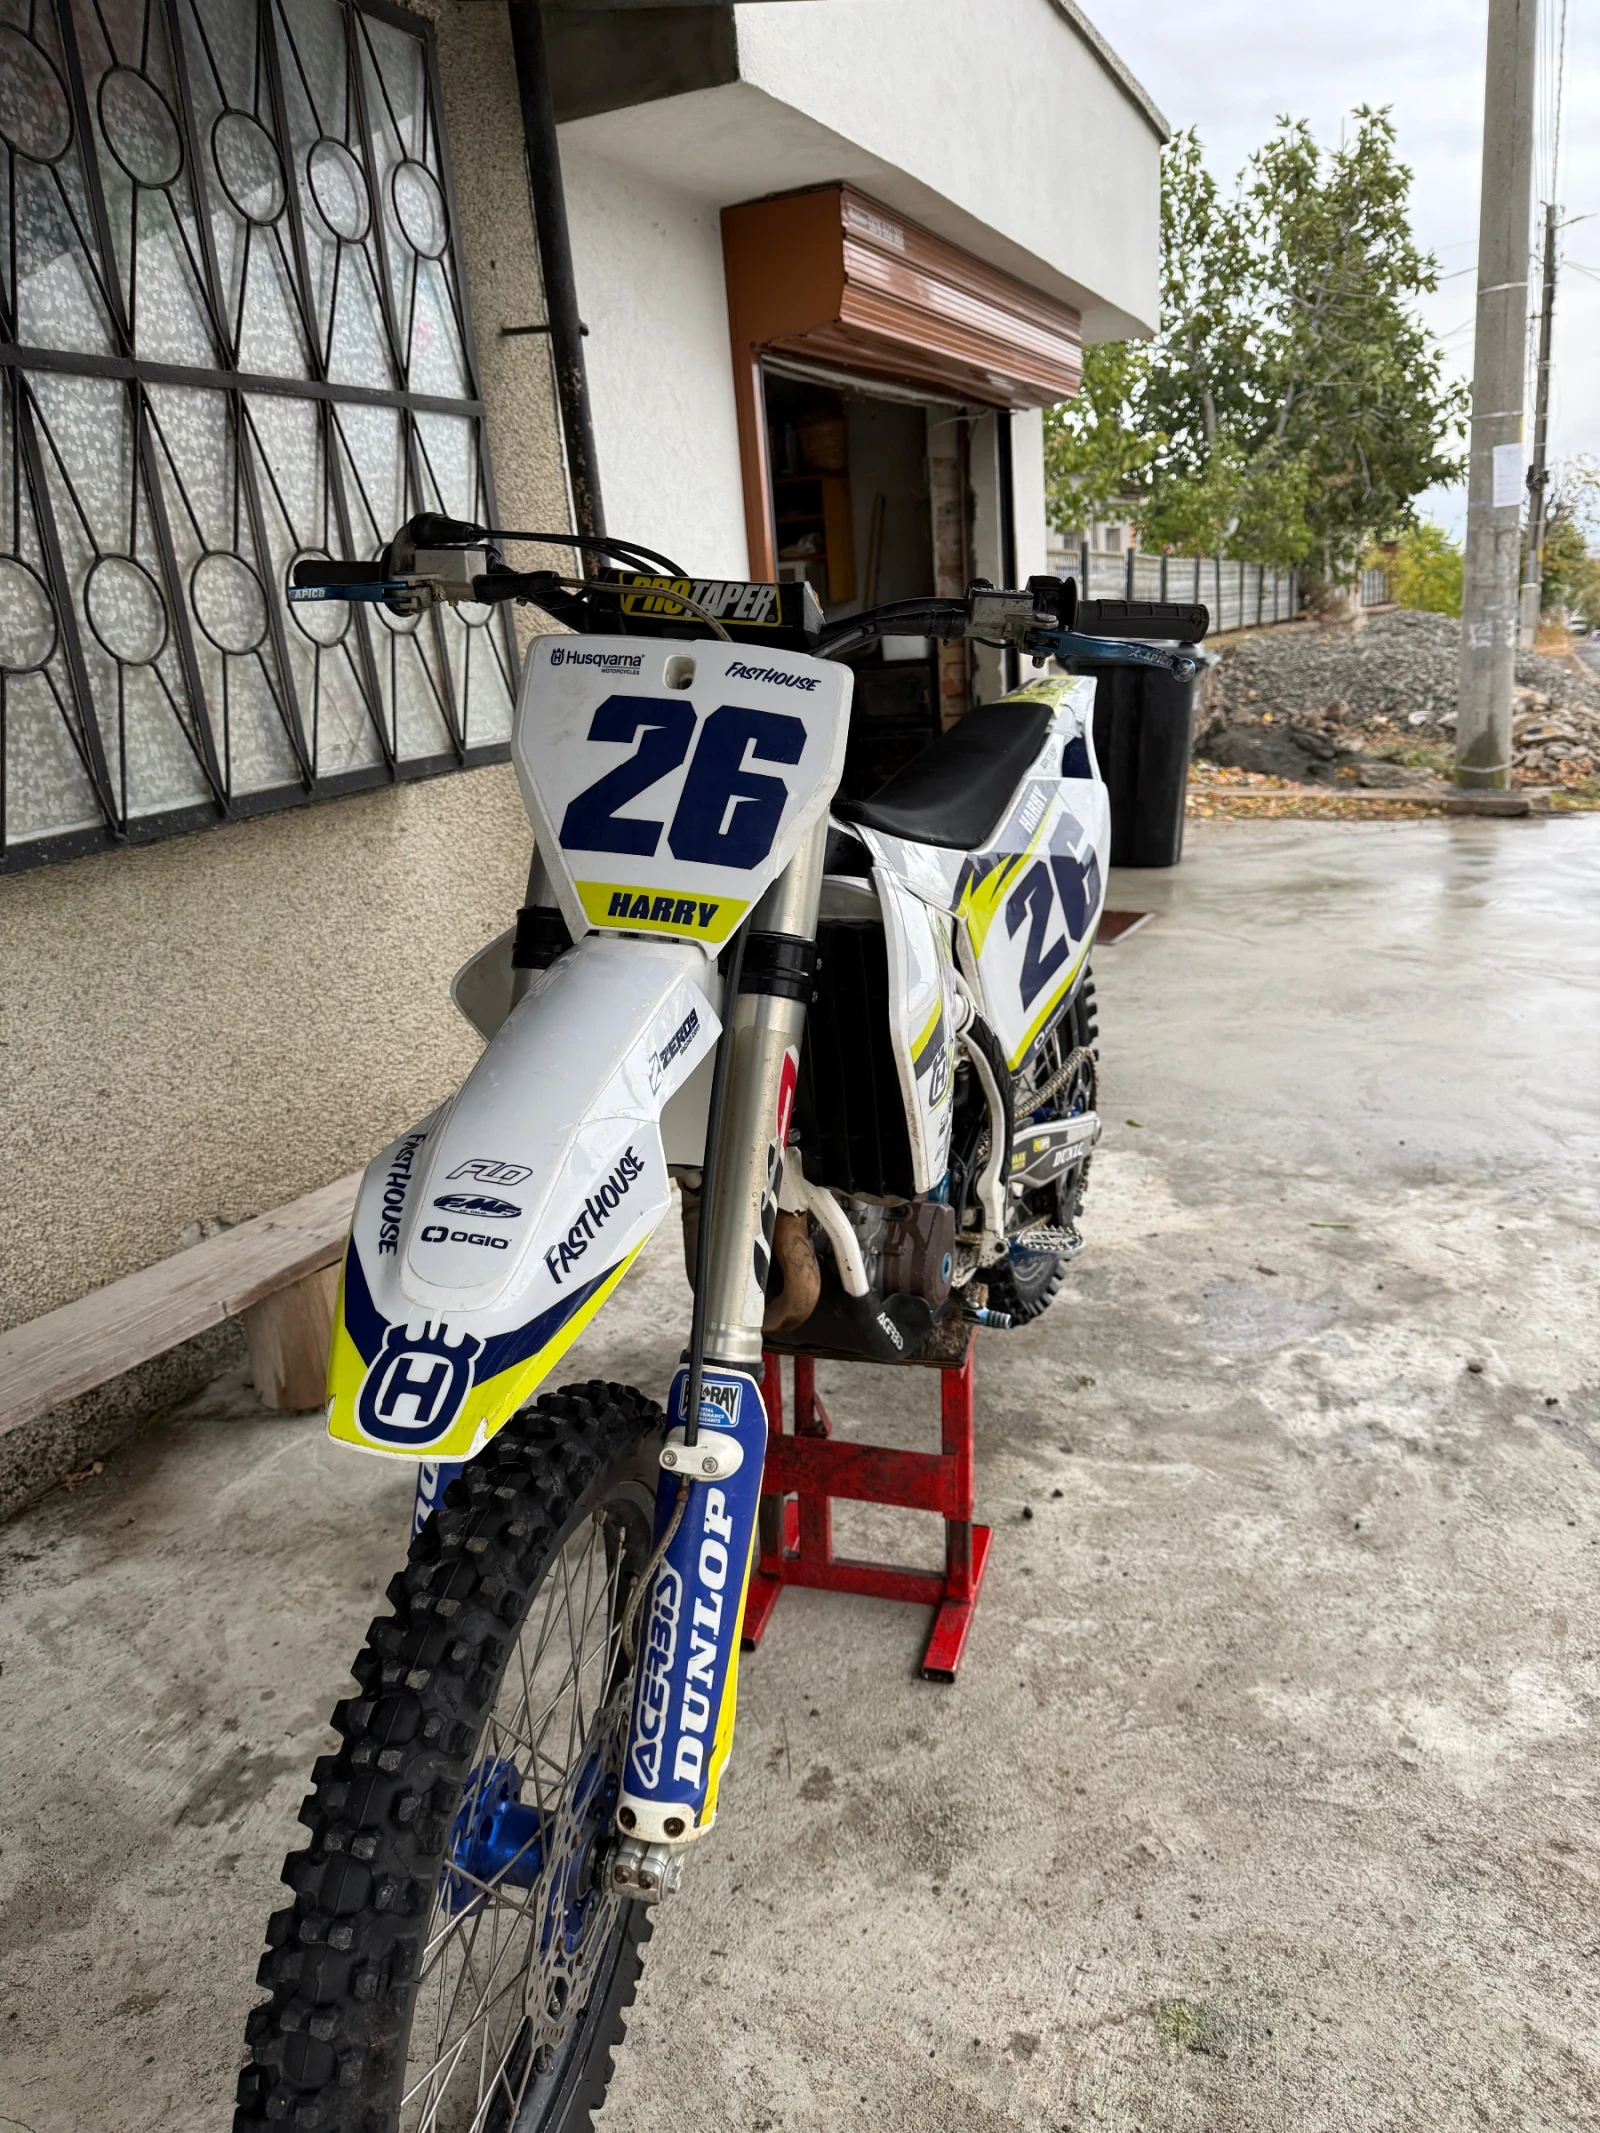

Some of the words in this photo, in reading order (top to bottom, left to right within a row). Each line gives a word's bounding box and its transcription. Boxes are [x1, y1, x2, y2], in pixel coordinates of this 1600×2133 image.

[295, 589, 325, 599] APICO
[625, 576, 776, 622] PROTAPER
[566, 651, 641, 668] Husqvarna
[601, 668, 640, 676] MOTORCYCLES
[725, 662, 821, 691] FASTHOUSE
[1143, 652, 1174, 667] APICO
[559, 695, 807, 870] 26
[1019, 785, 1048, 834] HARRY
[607, 892, 719, 928] HARRY
[1005, 812, 1100, 1013] 26
[445, 1158, 533, 1186] FLO
[379, 1133, 428, 1256] FASTHOUSE
[434, 1196, 522, 1214] FMF
[543, 1146, 645, 1284] FASTHOUSE
[450, 1231, 509, 1249] OGIO
[673, 1487, 733, 1790] DUNLOP
[632, 1568, 683, 1790] ACERBIS
